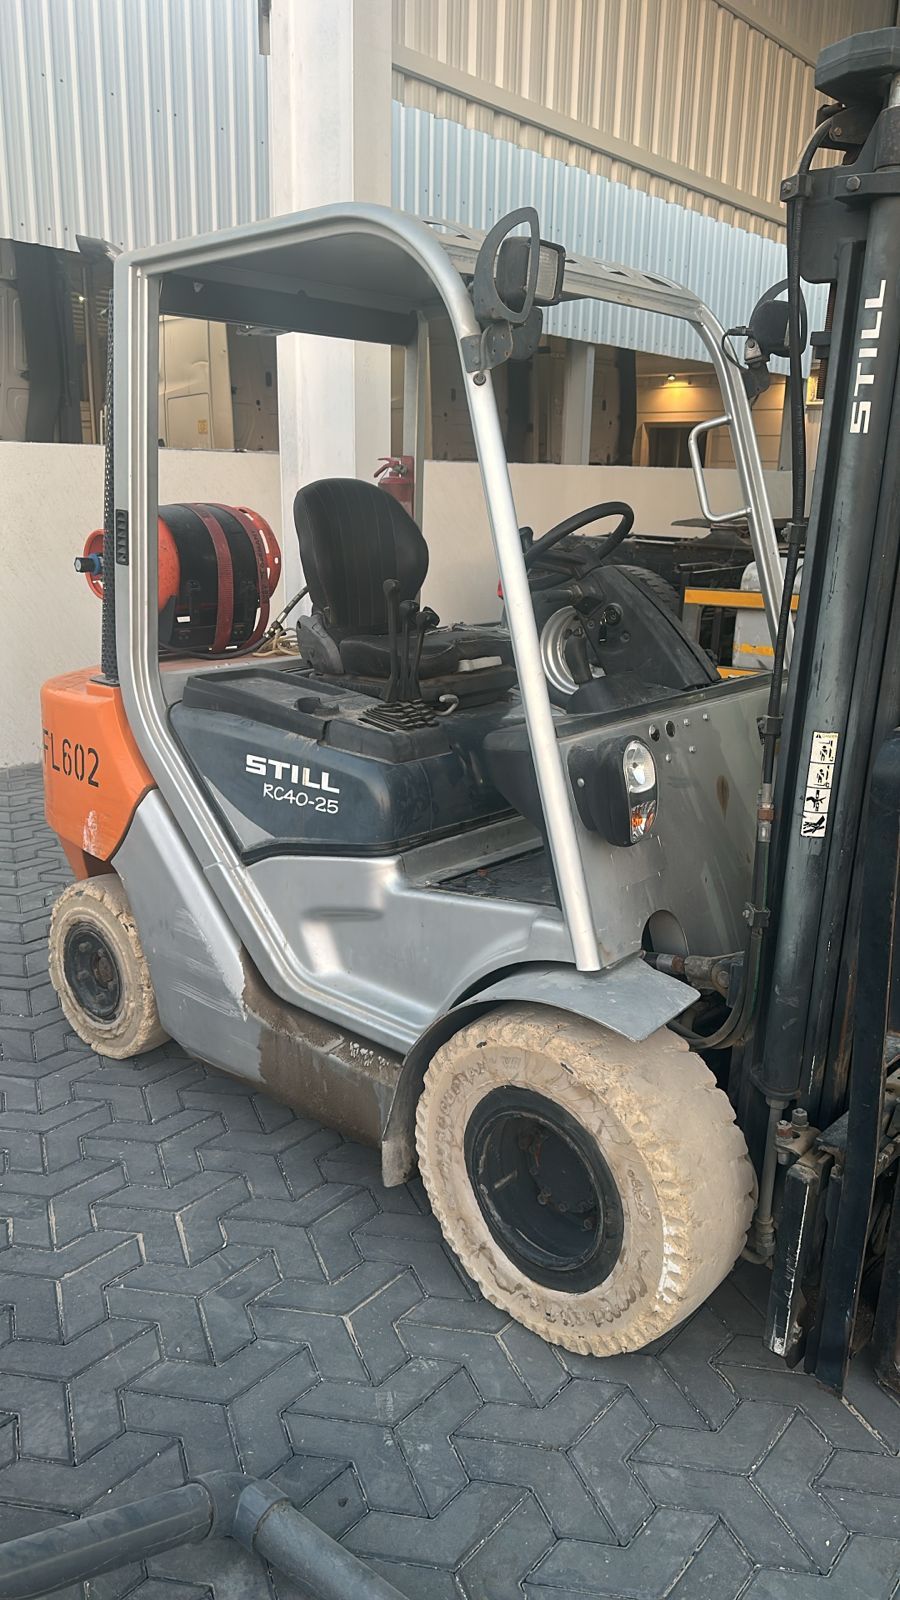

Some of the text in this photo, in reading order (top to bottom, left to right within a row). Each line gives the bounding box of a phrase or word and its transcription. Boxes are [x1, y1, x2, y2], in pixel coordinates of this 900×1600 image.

[849, 279, 887, 434] STILL
[42, 728, 99, 788] FL602
[245, 754, 340, 794] STILL
[263, 782, 339, 814] RC40-25
